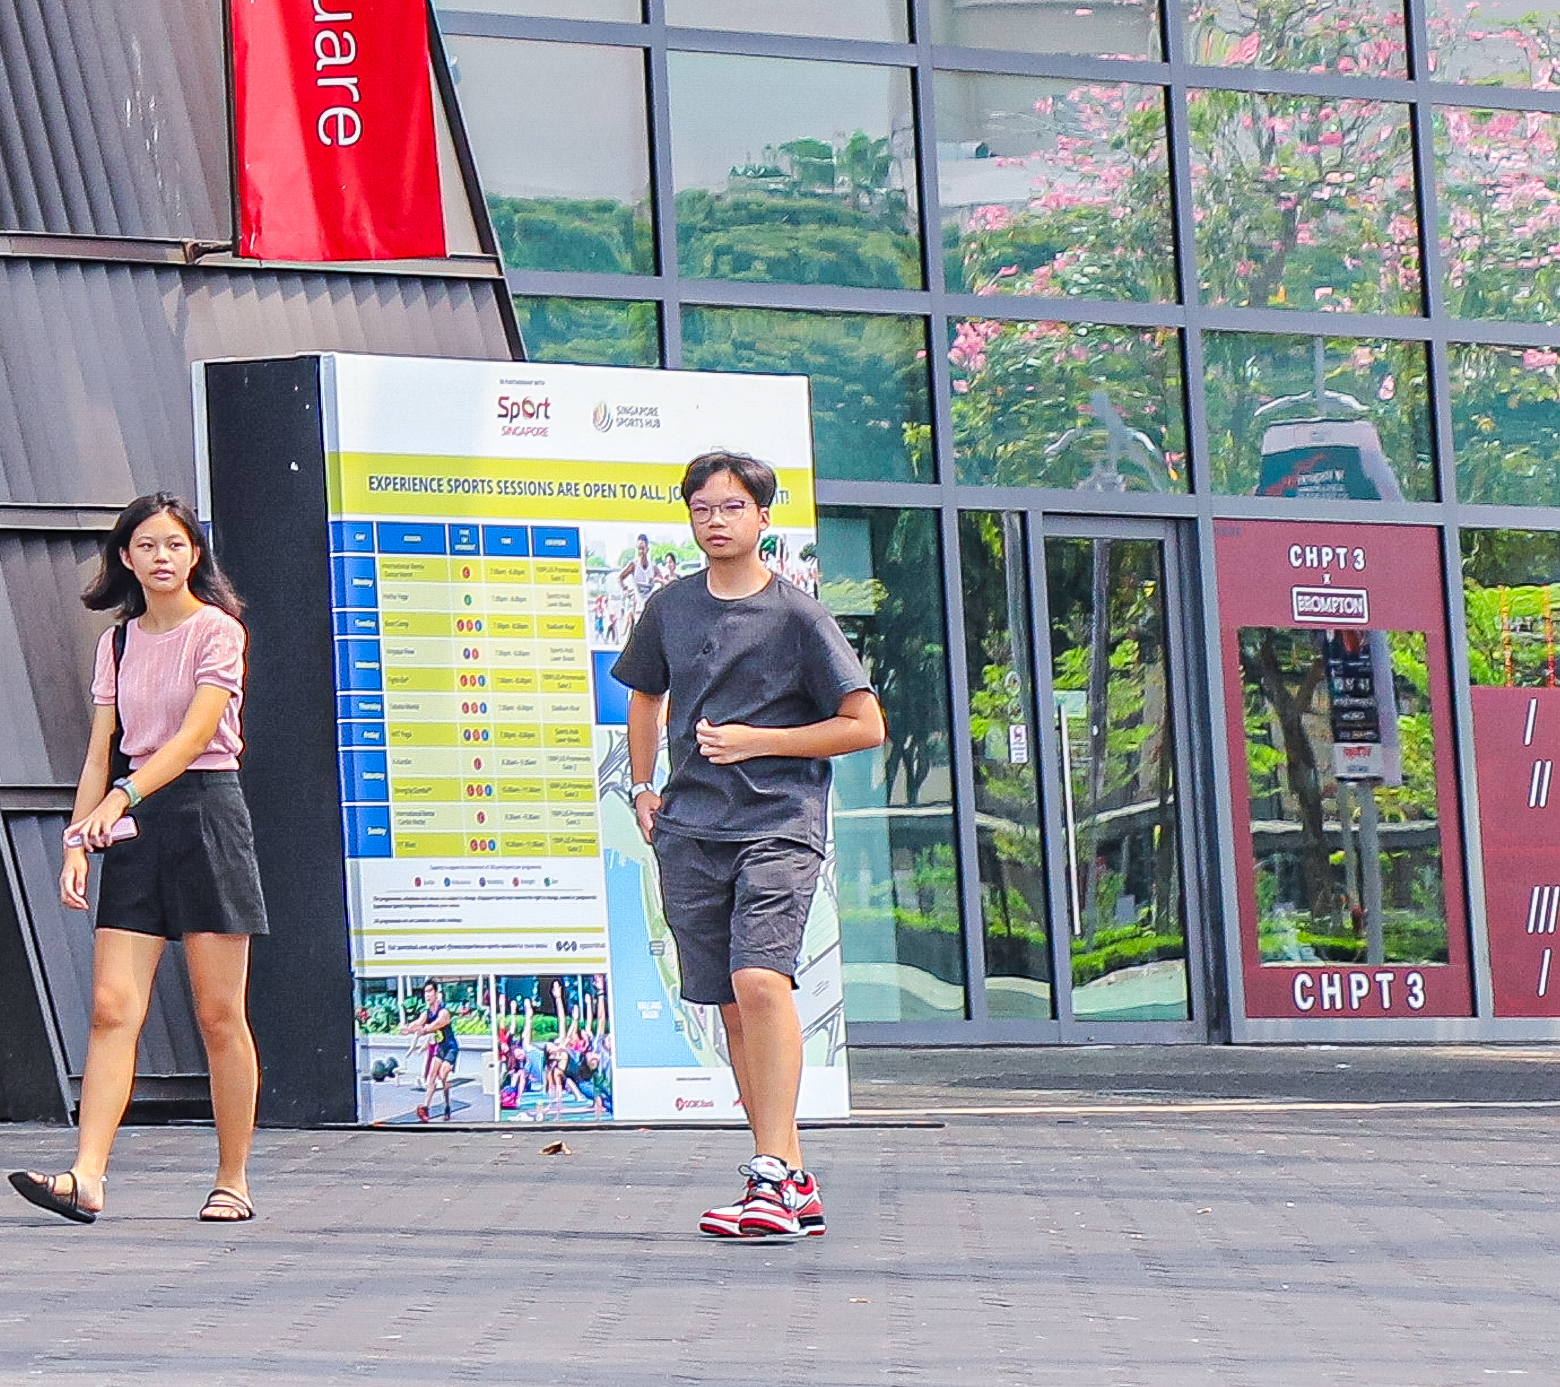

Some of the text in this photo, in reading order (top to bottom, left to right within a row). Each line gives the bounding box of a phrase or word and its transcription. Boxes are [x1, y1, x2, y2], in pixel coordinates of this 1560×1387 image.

[497, 395, 551, 423] Sport
[616, 405, 660, 417] SINGAPORE
[501, 426, 550, 437] SINGAPORE
[369, 476, 444, 493] EXPERIENCE
[447, 477, 494, 494] SPORTS
[497, 479, 554, 497] SESSIONS
[556, 482, 580, 497] ARE
[583, 483, 617, 498] OPEN
[621, 484, 637, 499] TO
[640, 485, 666, 500] ALL.
[1289, 544, 1365, 570] CHPT 3
[1292, 972, 1426, 1011] CHPT 3
